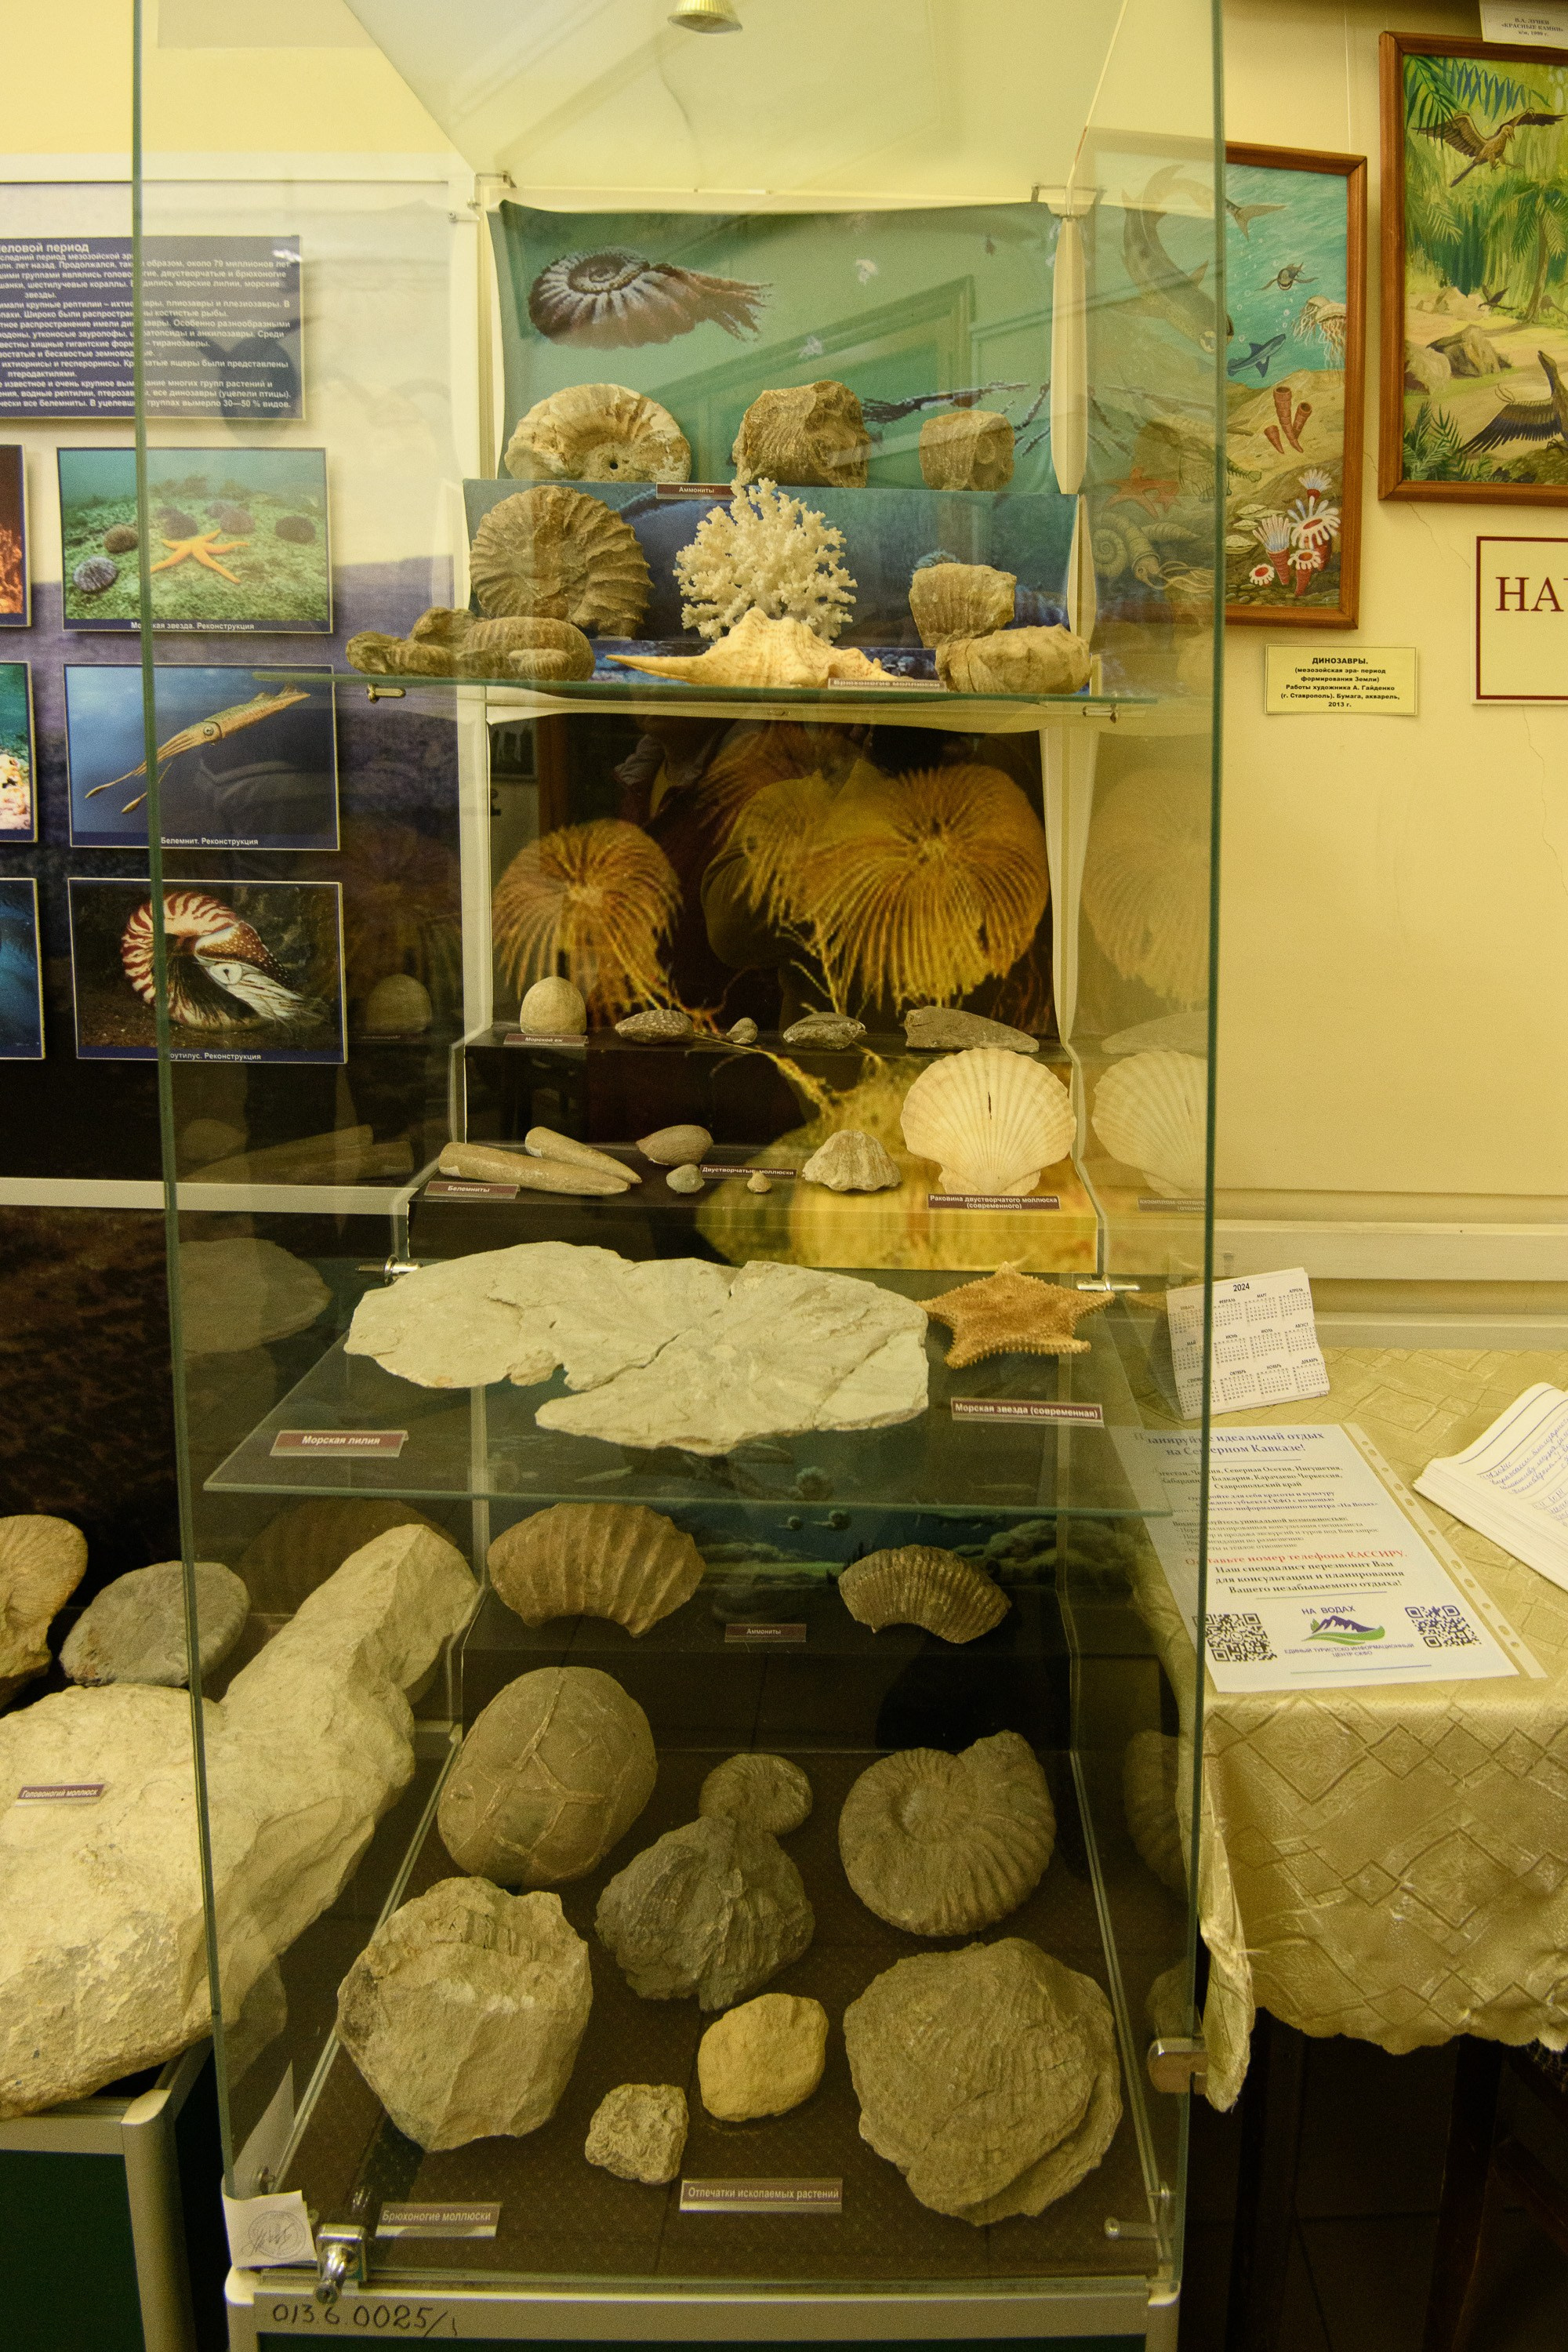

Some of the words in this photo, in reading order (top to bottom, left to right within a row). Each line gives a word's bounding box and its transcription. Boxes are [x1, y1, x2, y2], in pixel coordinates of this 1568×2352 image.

[0, 243, 44, 253] еловой
[47, 244, 89, 255] период
[1495, 576, 1568, 612] НА
[197, 622, 255, 632] Реконструкция
[161, 837, 200, 845] Белемнит.
[201, 837, 259, 847] Реконструкция
[204, 1051, 261, 1062] Реконструкция
[1232, 1283, 1250, 1292] 2024
[955, 1403, 995, 1414] Морская
[996, 1404, 1029, 1415] звезда
[1030, 1406, 1098, 1420] (современная)
[301, 1435, 347, 1446] Морская
[347, 1436, 381, 1445] лилия
[1217, 1432, 1285, 1443] идеальный
[1287, 1432, 1324, 1442] отдых
[1185, 1446, 1248, 1456] Сеерном
[1250, 1443, 1307, 1454] Кавказе!
[1288, 1552, 1345, 1562] телефона
[1243, 1564, 1305, 1573] специалист
[1308, 1563, 1370, 1571] перезвонит
[1237, 1573, 1312, 1584] консультации
[1325, 1570, 1405, 1581] планирования
[1229, 1586, 1270, 1595] Вашего
[1272, 1582, 1358, 1592] незабываемого
[1359, 1579, 1403, 1588] отдыха!
[1320, 1605, 1356, 1614] ВОДАХ
[746, 1627, 782, 1635] Аммониты
[22, 1789, 65, 1798] Головоногий
[688, 2187, 735, 2198] Отпечатки
[738, 2188, 794, 2199] ископаемых
[797, 2187, 839, 2201] растений
[382, 2209, 441, 2223] Брюхоногие
[442, 2212, 491, 2222] моллюски
